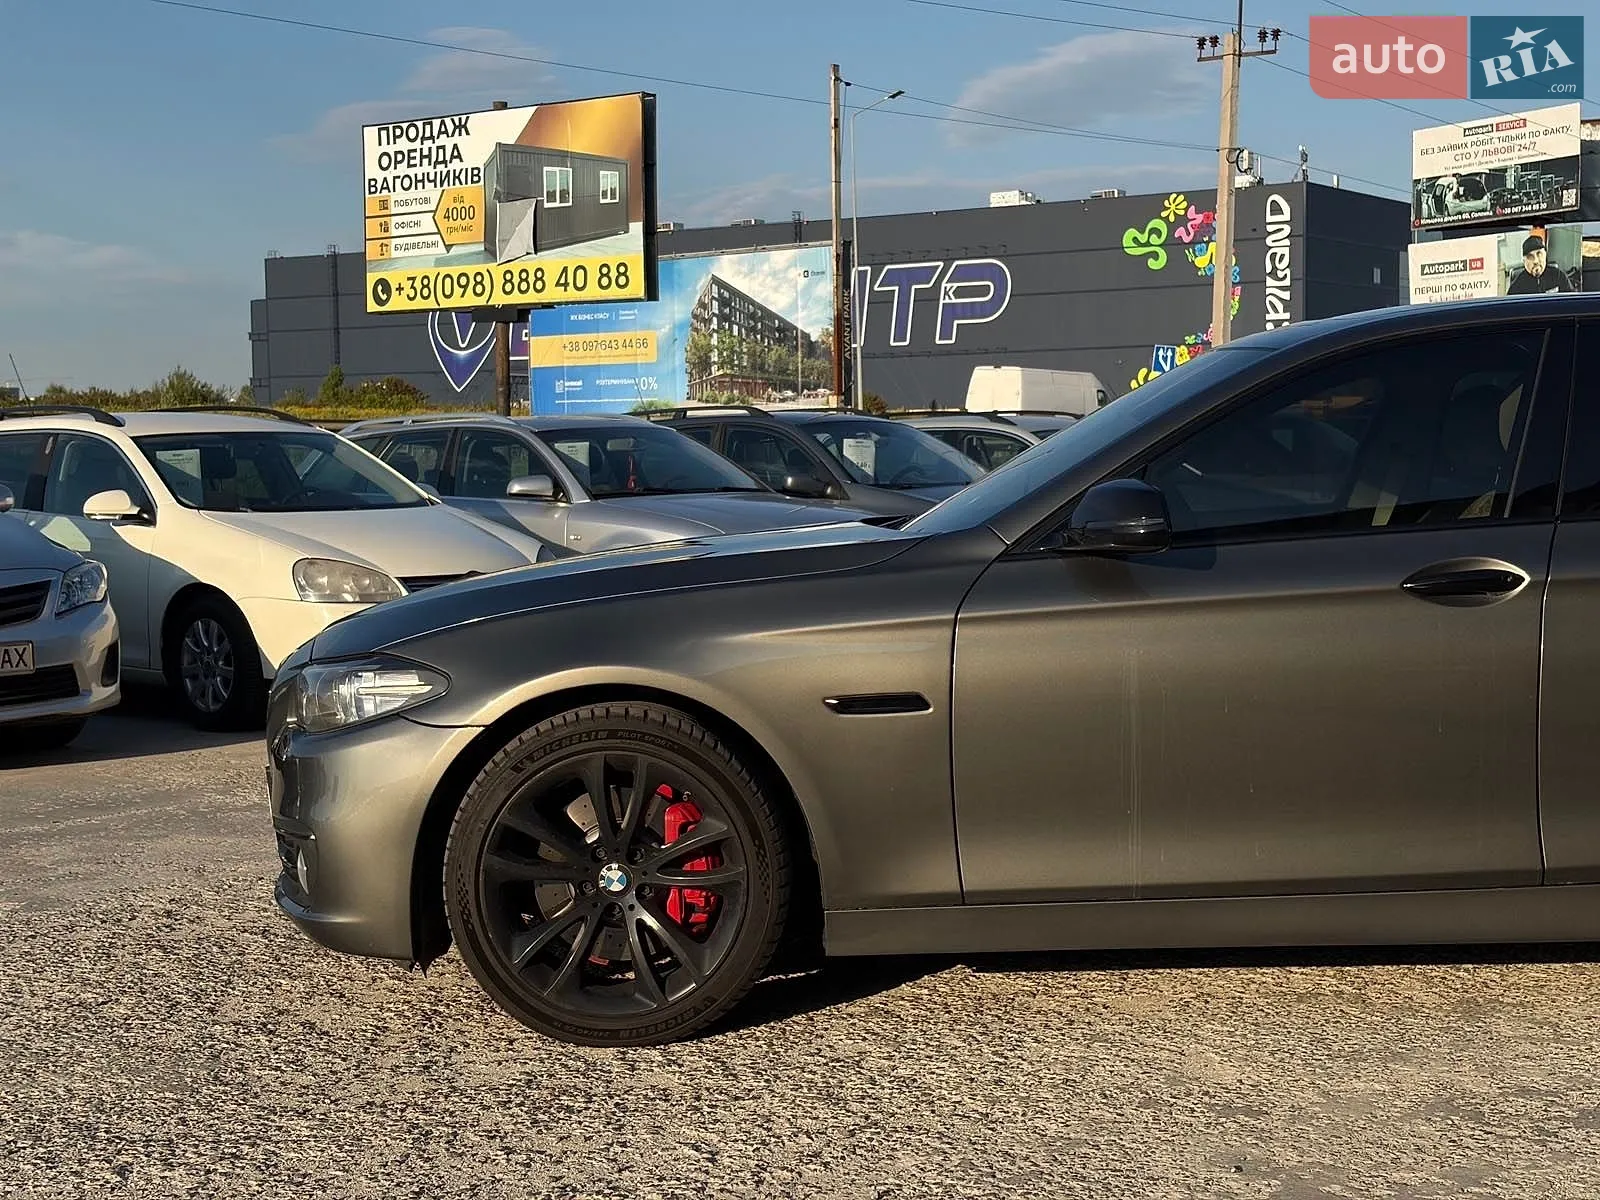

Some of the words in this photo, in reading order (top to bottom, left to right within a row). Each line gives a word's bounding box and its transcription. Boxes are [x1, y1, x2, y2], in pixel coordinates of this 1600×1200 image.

[377, 115, 471, 147] ПРОДАЖ
[1498, 120, 1525, 130] SERVICE
[1420, 147, 1435, 157] БЕЗ
[1436, 141, 1469, 154] ЗАЙВИХ
[1497, 133, 1526, 145] ТІЛЬКИ
[1529, 130, 1541, 140] ПО
[1542, 125, 1573, 137] ФАКТУ.
[378, 143, 464, 172] ОРЕНДА
[1454, 152, 1471, 162] СТО
[1473, 150, 1480, 160] У
[1481, 145, 1516, 158] ЛЬВОВІ
[1517, 142, 1537, 154] 24/7
[368, 166, 482, 196] ВАГОНЧИКІВ
[394, 197, 432, 208] ПОБУТОВІ
[452, 193, 465, 205] від
[443, 205, 476, 222] 4000
[394, 220, 421, 230] ОФІСНІ
[446, 222, 474, 234] грн/міс
[394, 240, 439, 252] БУДІВЕЛЬНІ
[1424, 260, 1464, 275] Autopark
[395, 268, 495, 306] +38(098)
[501, 267, 546, 296] 888
[555, 264, 588, 292] 40
[597, 262, 630, 290] 88
[1414, 285, 1442, 295] ПЕРШІ
[1445, 283, 1458, 292] ПО
[1459, 280, 1491, 291] ФАКТУ.
[562, 341, 580, 352] +38
[582, 340, 599, 352] 097
[599, 339, 619, 351] 643
[621, 338, 633, 349] 44
[635, 337, 649, 349] 66
[844, 320, 852, 359] AVANT
[1, 647, 27, 668] AX
[617, 731, 641, 741] PILOT
[533, 731, 609, 760] MICHELIN
